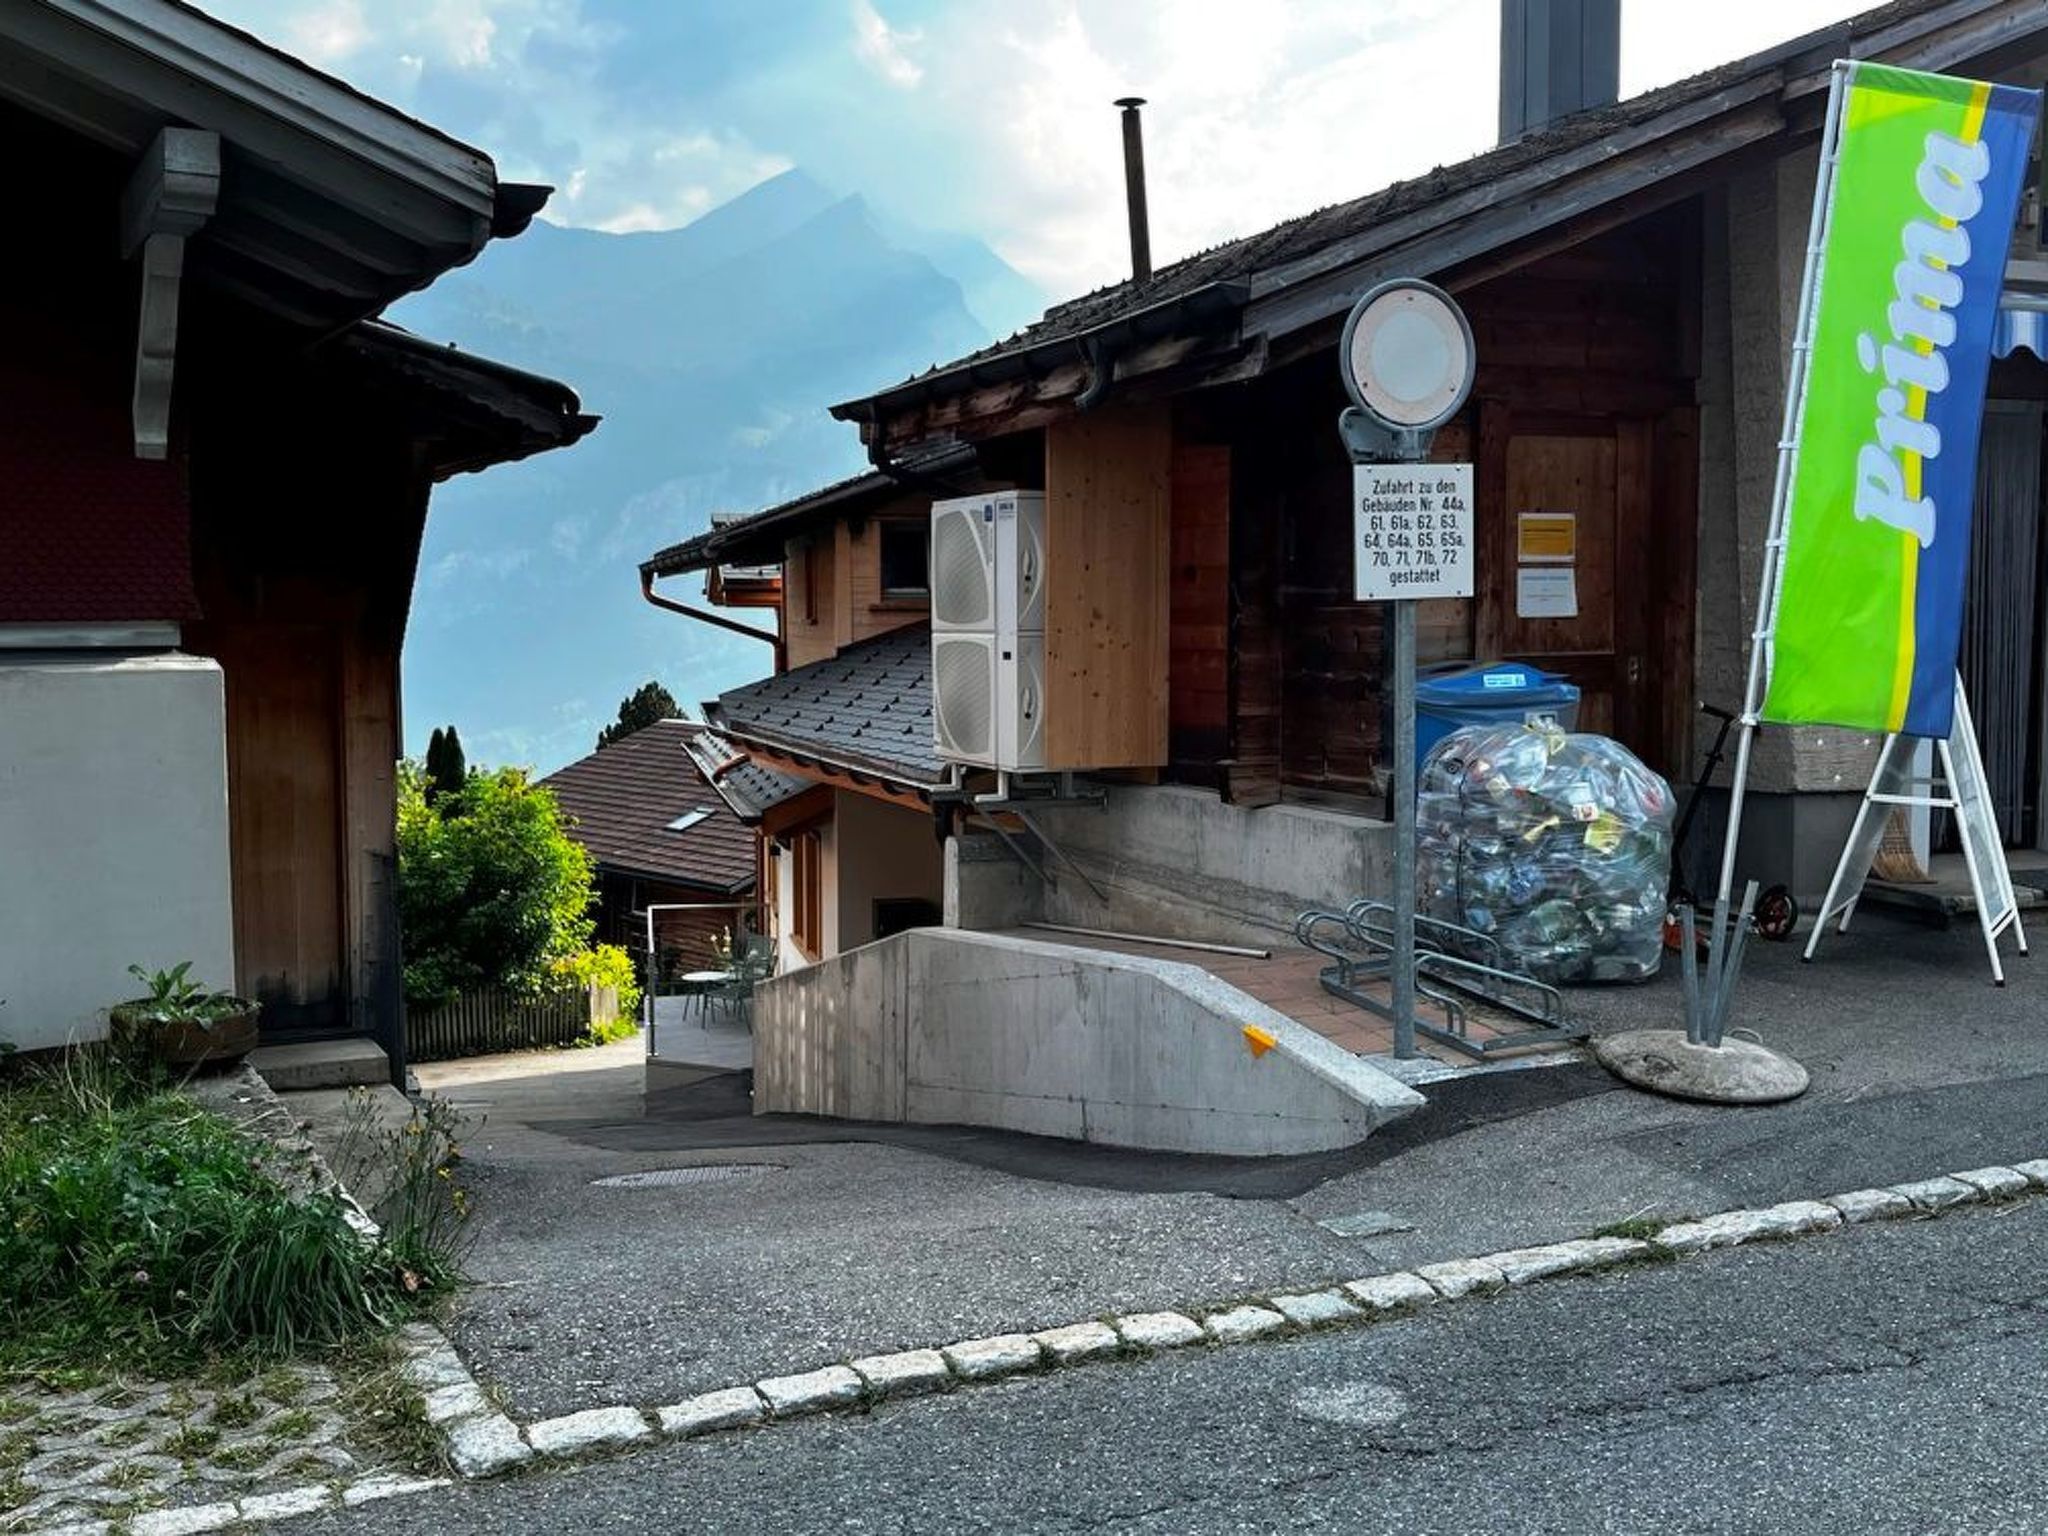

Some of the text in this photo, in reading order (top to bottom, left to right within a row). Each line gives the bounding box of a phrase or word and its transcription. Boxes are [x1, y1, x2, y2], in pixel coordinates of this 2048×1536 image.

[1854, 131, 1990, 548] Prima
[1372, 479, 1456, 495] Zufahrt zu den
[1362, 497, 1417, 513] Gebäuden
[1442, 549, 1458, 564] 72
[1389, 569, 1440, 587] gestattet
